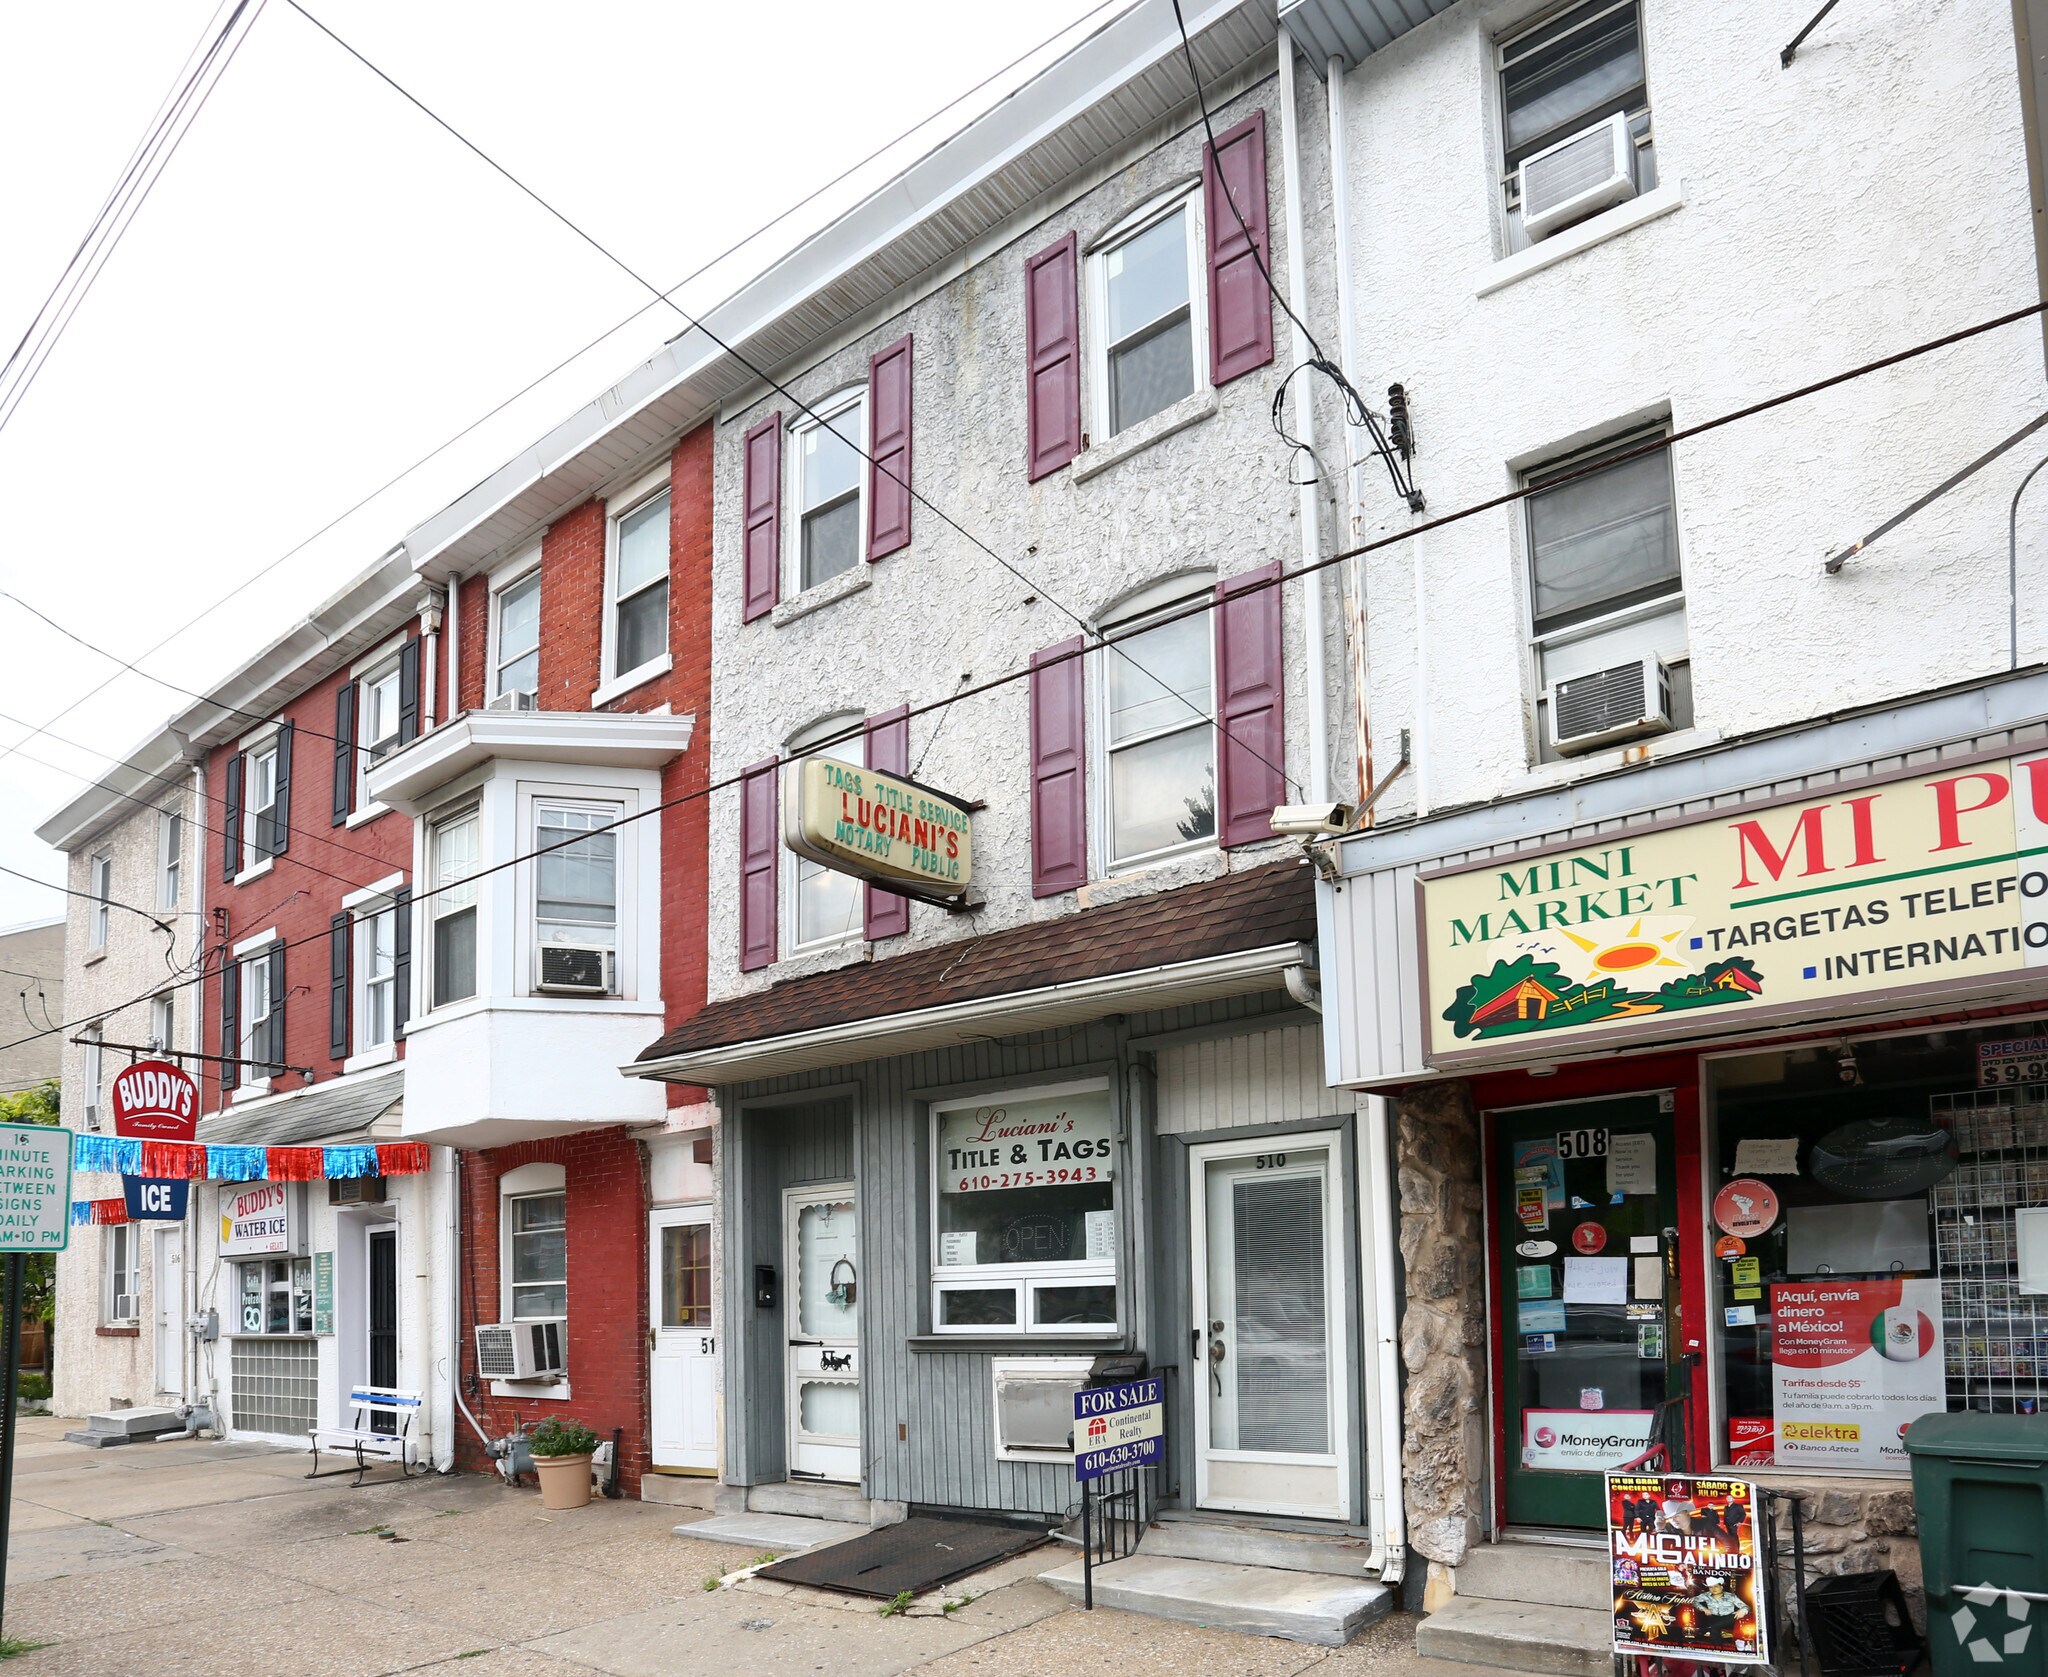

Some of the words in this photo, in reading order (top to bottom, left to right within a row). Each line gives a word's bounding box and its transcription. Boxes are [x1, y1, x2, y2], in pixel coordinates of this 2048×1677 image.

[824, 764, 863, 796] TAGS
[875, 782, 913, 814] TITLE
[918, 799, 968, 834] SERVICE
[841, 792, 959, 859] LUCIANI'S
[1728, 793, 1887, 890] MI
[834, 820, 893, 857] NOTARY
[911, 846, 960, 880] PUBLIC
[1496, 845, 1636, 901] MINI
[1448, 873, 1698, 948] MARKET
[1707, 900, 1890, 952] TARGETAS
[1982, 1059, 2000, 1067] DVD
[1984, 1066, 1999, 1084] $
[118, 1071, 193, 1117] BUDDY'S
[965, 1106, 1074, 1143] Luciani's
[1559, 1129, 1607, 1158] 508
[0, 1149, 50, 1163] INUTE
[1010, 1143, 1027, 1165] &
[1257, 1152, 1286, 1170] 510
[958, 1167, 1097, 1191] 610-275-3943
[0, 1182, 56, 1195] TWEEN
[140, 1184, 172, 1212] ICE
[237, 1183, 284, 1218] BUDDY'S
[1520, 1210, 1542, 1219] Card
[234, 1221, 266, 1238] WATER
[269, 1219, 286, 1234] ICE
[42, 1231, 60, 1243] PM
[1006, 1225, 1065, 1251] OPEN
[1777, 1291, 1817, 1304] ¡Aquí,
[1819, 1289, 1860, 1301] envía
[1777, 1306, 1825, 1317] dinero
[1777, 1324, 1787, 1333] a
[1789, 1321, 1843, 1333] México!
[1796, 1338, 1847, 1346] MoneyGram
[1779, 1347, 1797, 1356] llega
[1782, 1379, 1815, 1388] Tarifas
[1817, 1379, 1847, 1388] desde
[1081, 1391, 1116, 1415] FOR
[1119, 1382, 1157, 1408] SALE
[1793, 1392, 1819, 1400] familia
[1820, 1393, 1845, 1401] puede
[1109, 1409, 1151, 1428] Continental
[1120, 1425, 1142, 1440] Realty
[1800, 1426, 1858, 1440] elektra
[1088, 1436, 1107, 1446] ERA
[1561, 1434, 1649, 1449] MoneyGram
[1800, 1444, 1827, 1452] Banco
[1085, 1439, 1155, 1471] 610-630-3700
[1596, 1449, 1623, 1458] dinero
[1696, 1480, 1728, 1490] SÁBADO
[1697, 1489, 1718, 1497] JULIO
[1729, 1482, 1746, 1498] 8
[1692, 1569, 1732, 1577] BANDON
